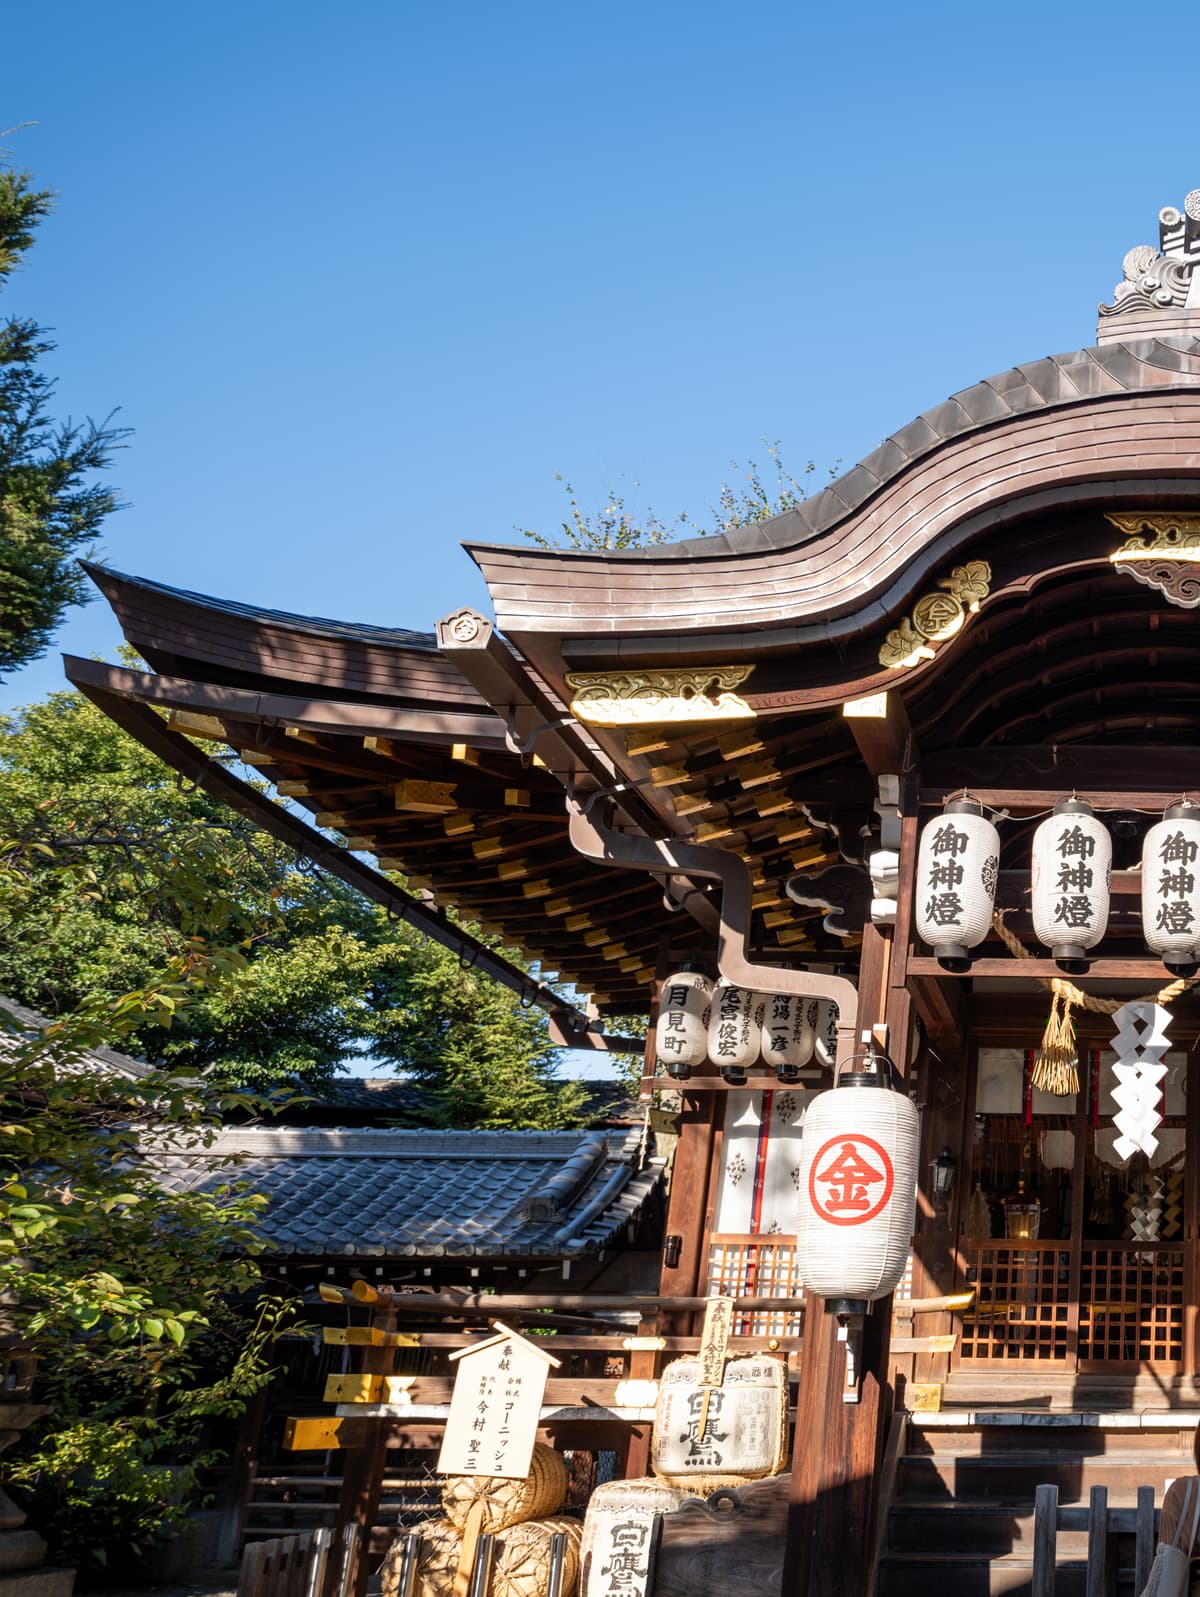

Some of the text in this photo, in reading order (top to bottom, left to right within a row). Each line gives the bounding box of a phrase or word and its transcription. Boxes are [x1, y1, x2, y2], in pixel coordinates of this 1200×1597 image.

[925, 823, 969, 926] 御神燈
[1054, 825, 1096, 928] 御神燈
[1156, 830, 1199, 935] 御神燈
[664, 985, 690, 1055] 月見町
[816, 1143, 885, 1212] 金
[498, 1345, 513, 1371] 奉献
[464, 1400, 489, 1470] 今村聖三
[494, 1402, 515, 1471] コーニッシュ
